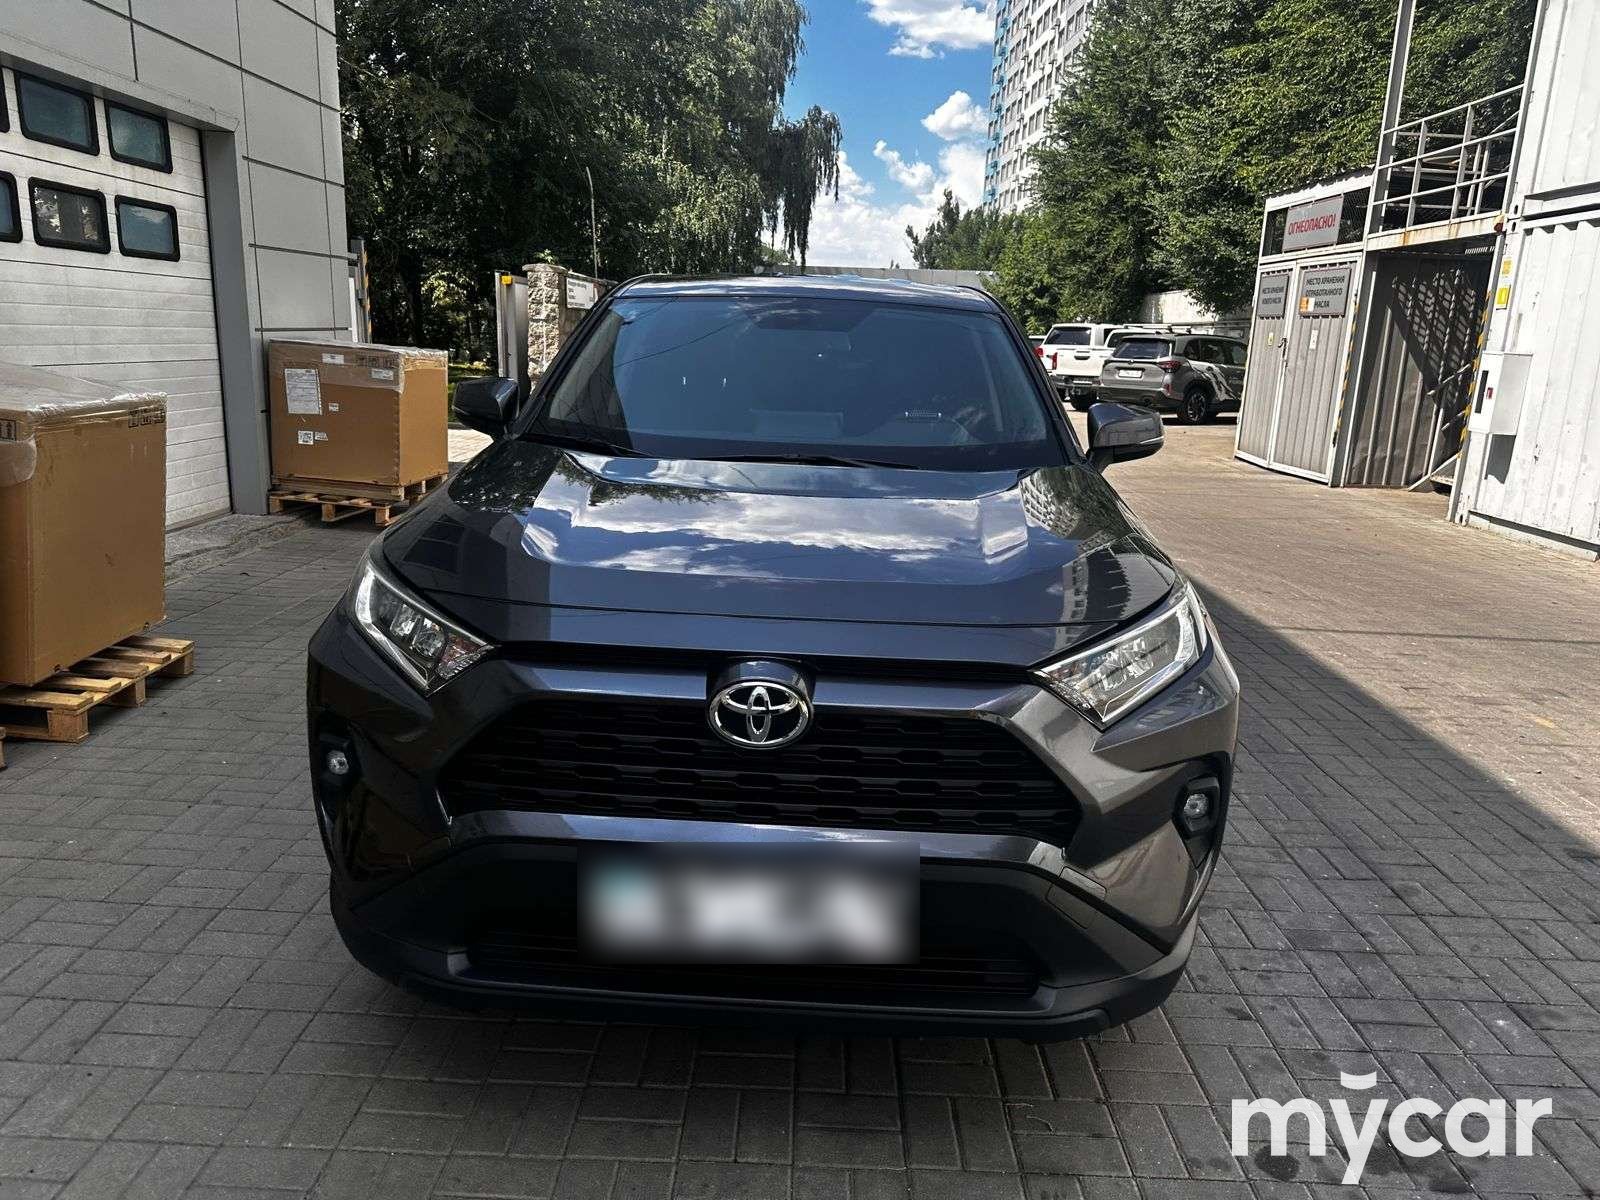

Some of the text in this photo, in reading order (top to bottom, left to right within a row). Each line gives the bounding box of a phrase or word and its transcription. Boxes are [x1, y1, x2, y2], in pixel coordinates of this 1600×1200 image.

[1288, 214, 1336, 235] ОГНЕОПАСНО!
[1306, 277, 1321, 286] МЕСТО
[1314, 300, 1330, 309] МАСЛА
